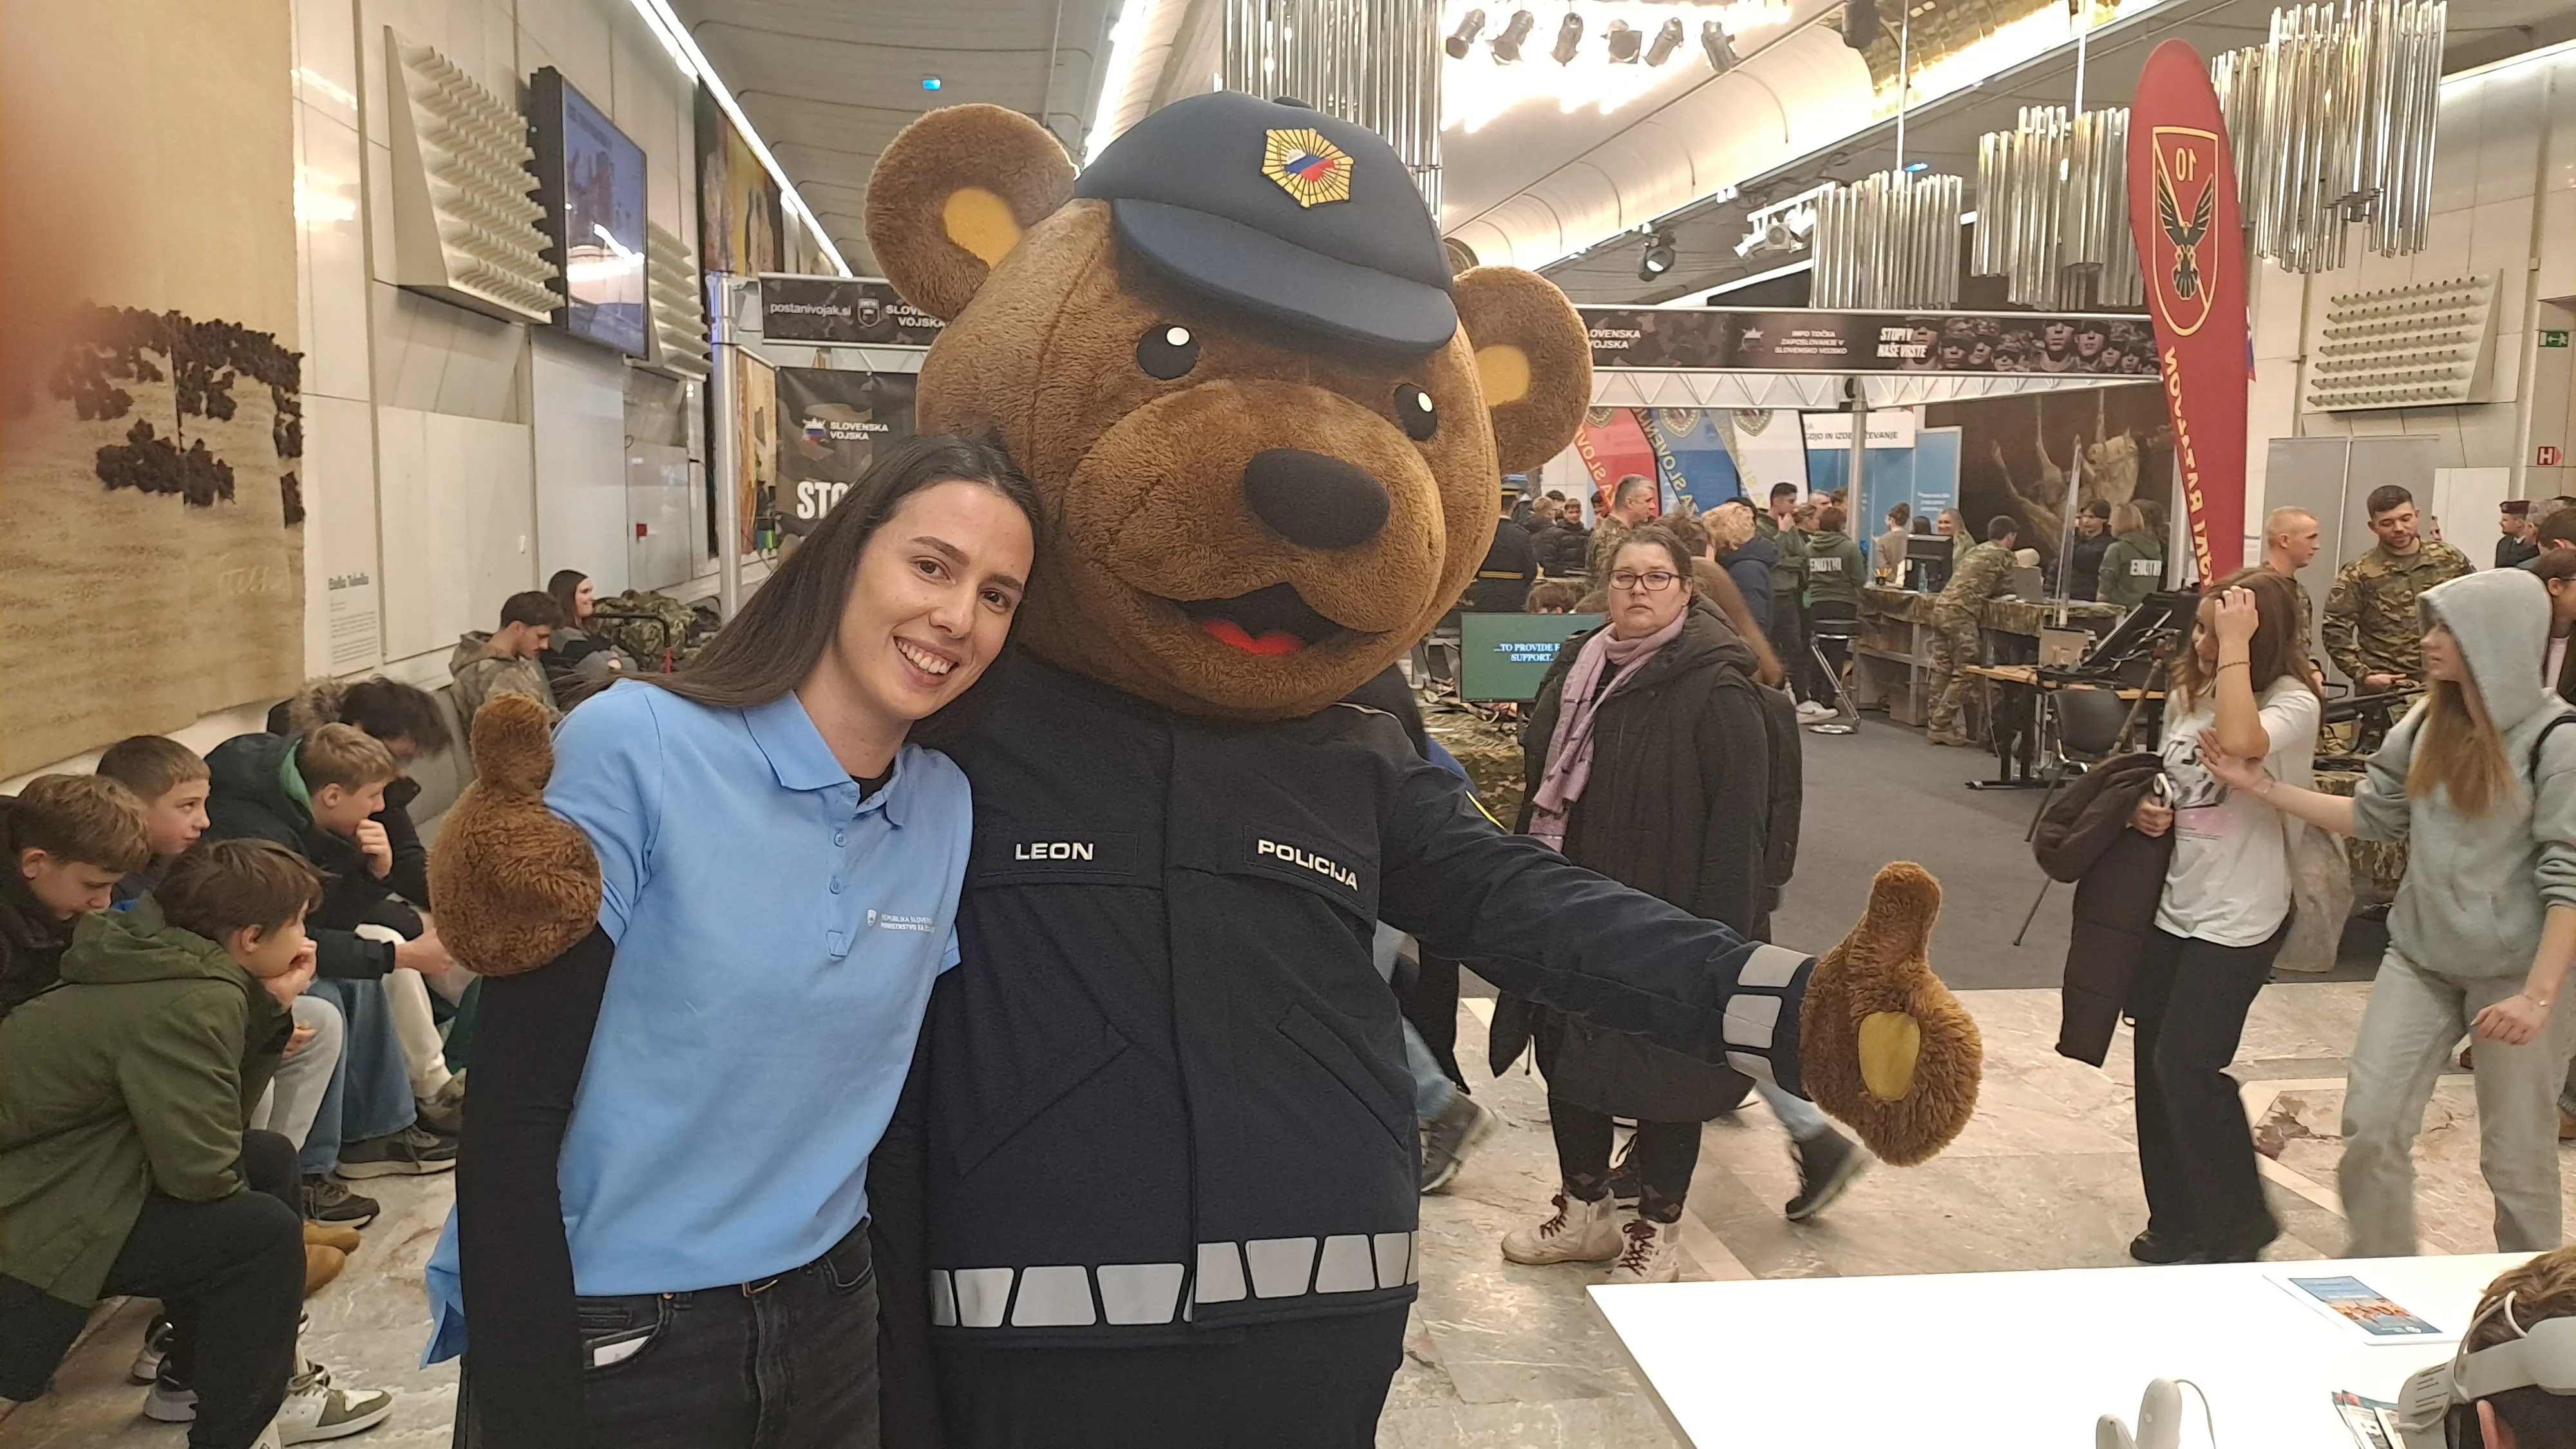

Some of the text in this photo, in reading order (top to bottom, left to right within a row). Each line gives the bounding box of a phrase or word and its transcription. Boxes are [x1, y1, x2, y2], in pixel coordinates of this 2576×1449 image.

[770, 303, 851, 317] postanivojak.si
[1588, 328, 1642, 339] OVENSKA
[829, 421, 889, 432] SLOVENSKA
[829, 431, 869, 440] VOJSKA
[2539, 448, 2553, 464] H
[1514, 643, 1553, 652] PROVIDE
[1015, 842, 1094, 860] LEON
[1257, 838, 1359, 892] POLICIJA
